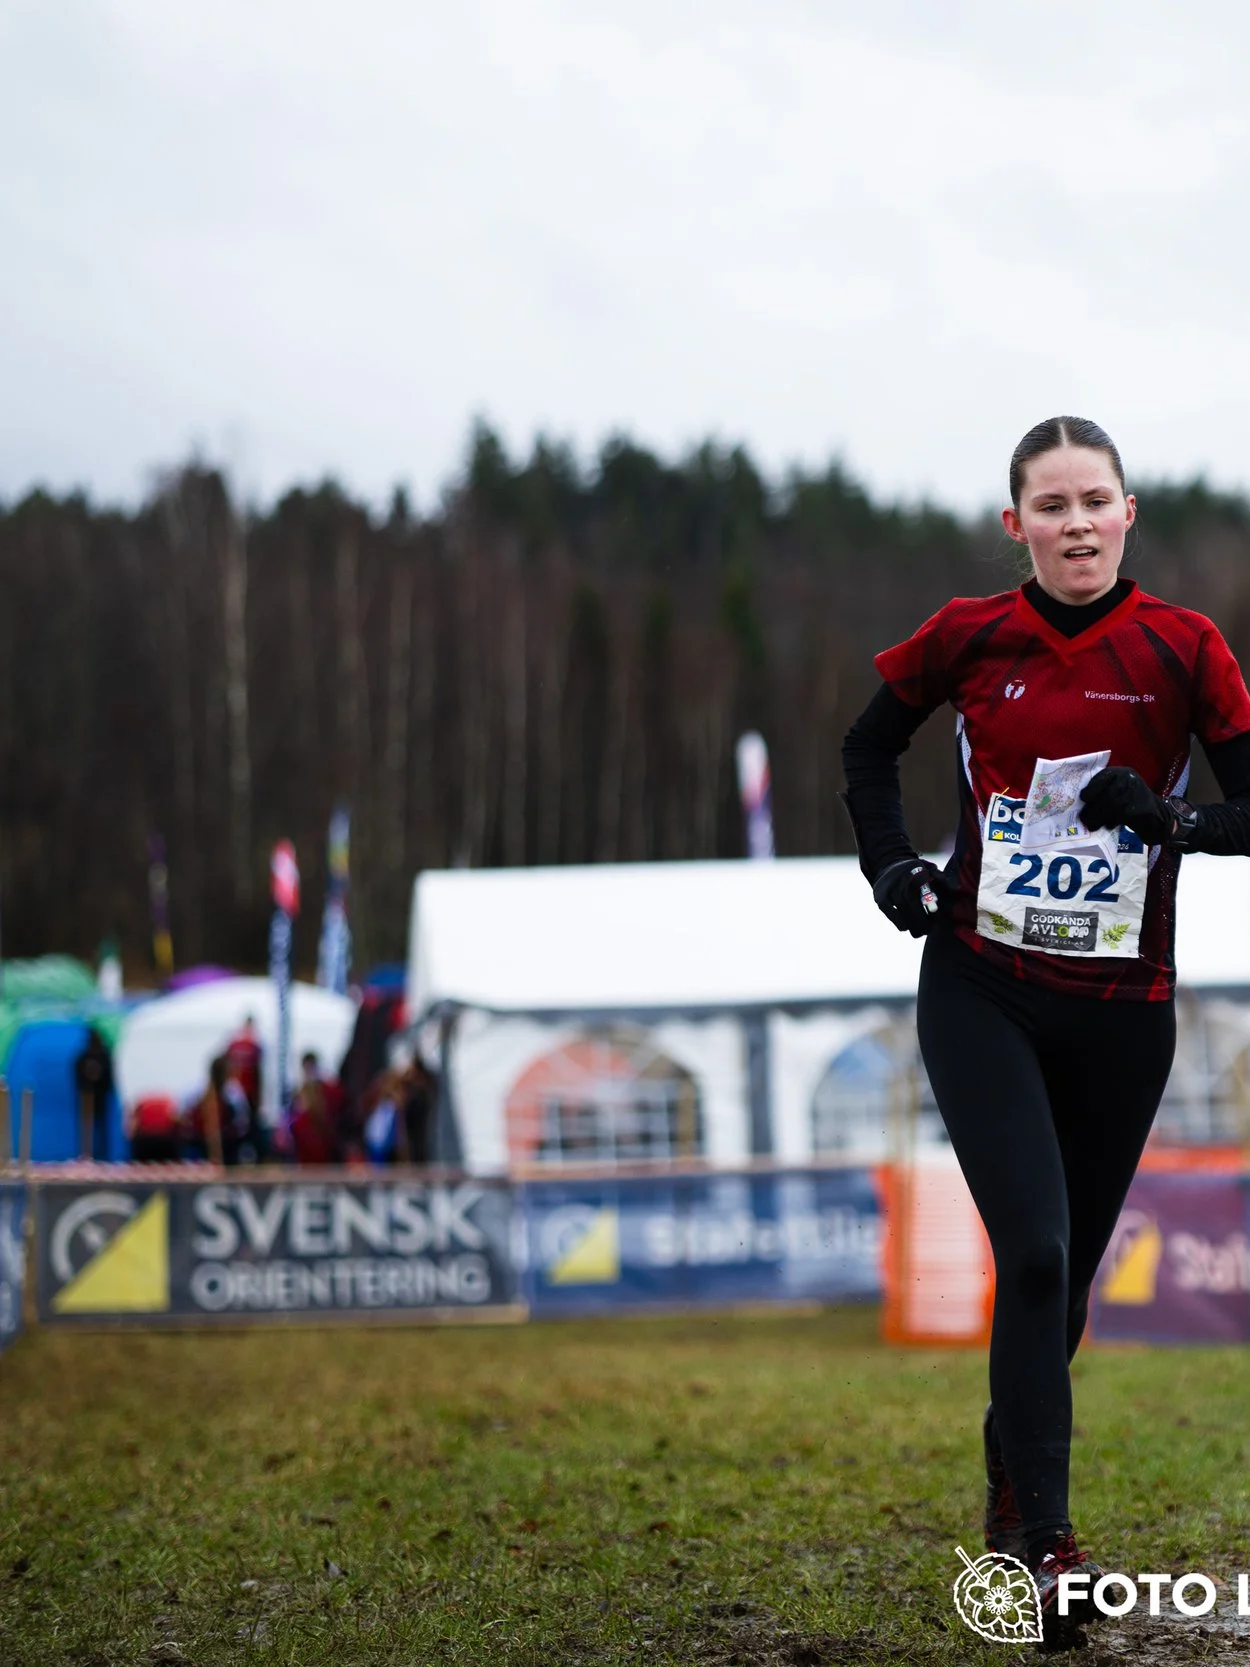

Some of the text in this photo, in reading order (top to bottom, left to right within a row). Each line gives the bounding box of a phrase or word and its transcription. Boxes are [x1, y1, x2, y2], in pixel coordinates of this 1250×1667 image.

[1085, 690, 1156, 704] Vänersborgs SK
[1005, 852, 1120, 903] 202
[1031, 914, 1091, 926] GODKÄNDA
[192, 1184, 486, 1260] SVENSK
[190, 1254, 493, 1312] ORIENTERING
